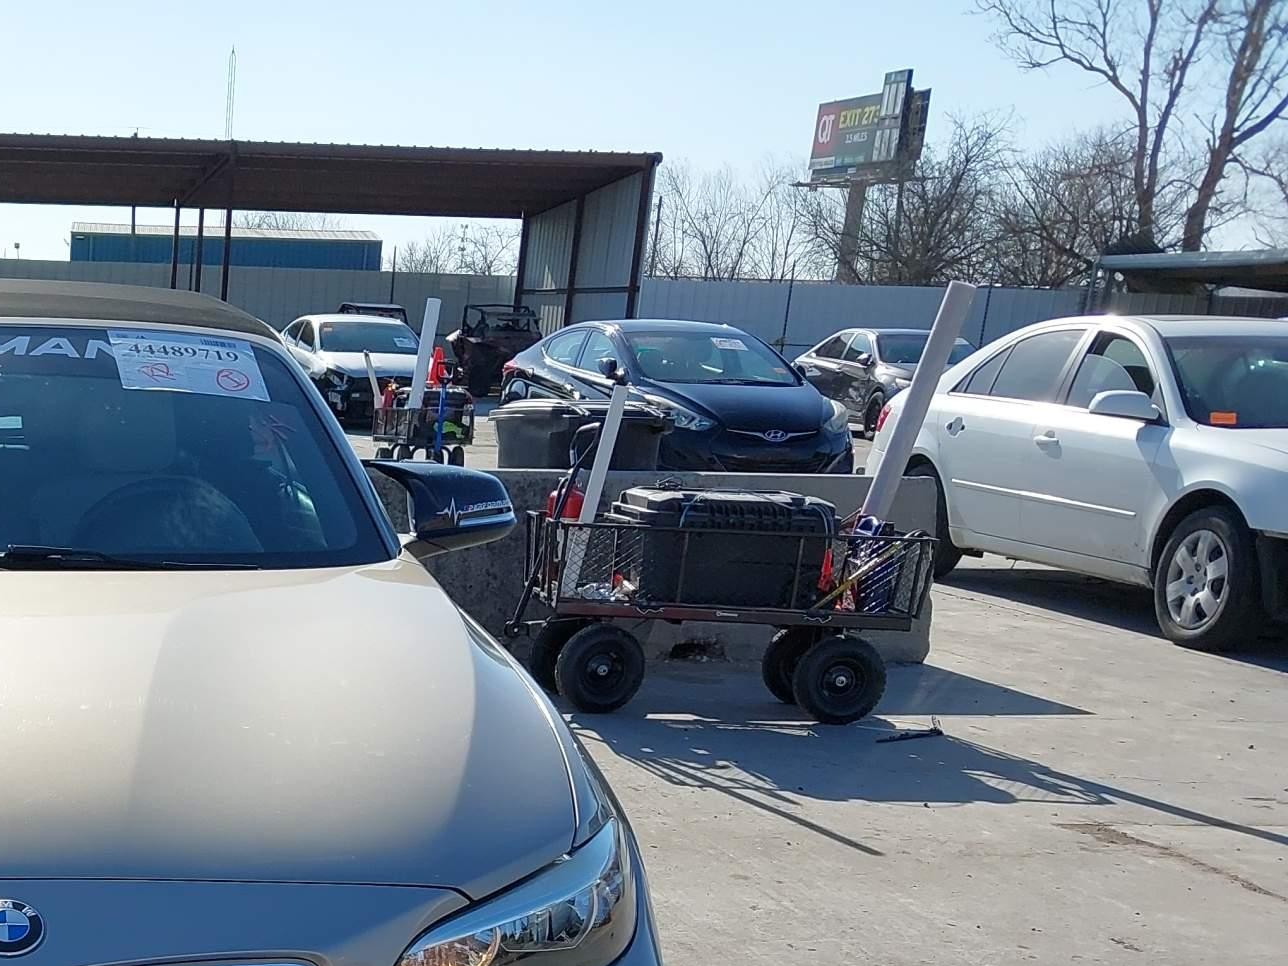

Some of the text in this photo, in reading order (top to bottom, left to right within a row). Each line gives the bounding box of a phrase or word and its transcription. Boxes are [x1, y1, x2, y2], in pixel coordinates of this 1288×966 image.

[839, 108, 862, 128] EXIT
[818, 114, 835, 144] QT
[129, 343, 239, 362] 44489719
